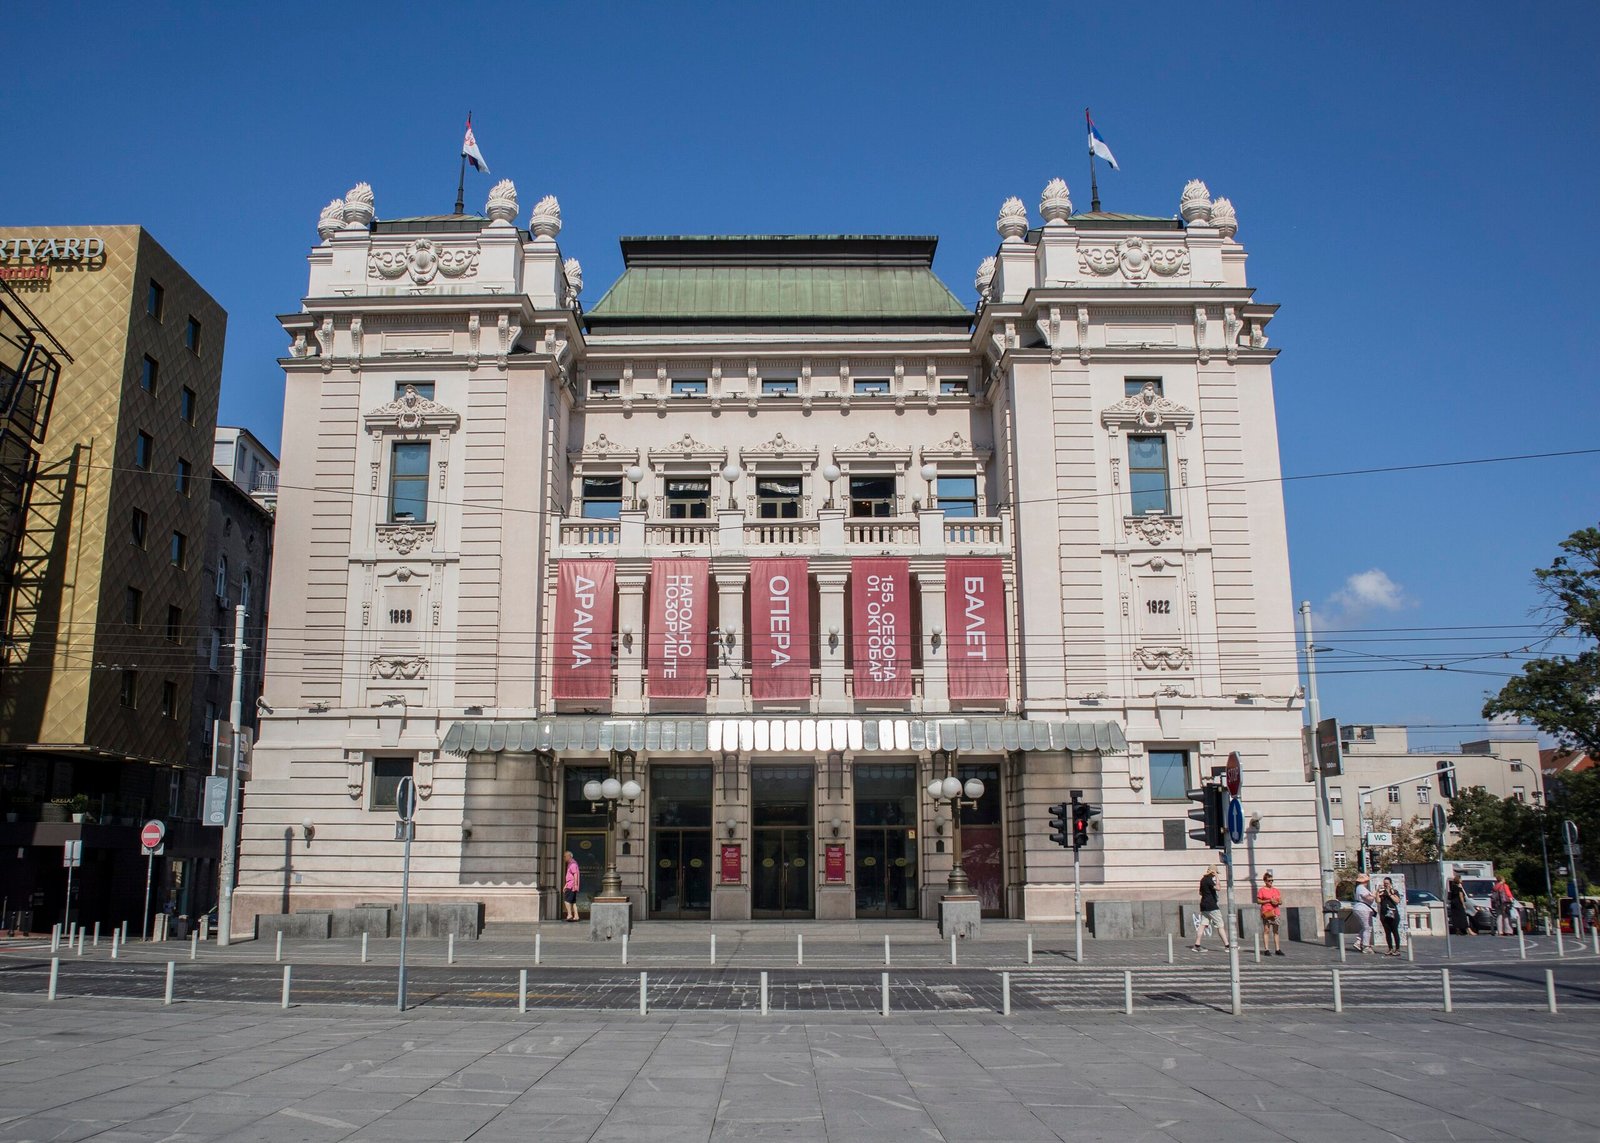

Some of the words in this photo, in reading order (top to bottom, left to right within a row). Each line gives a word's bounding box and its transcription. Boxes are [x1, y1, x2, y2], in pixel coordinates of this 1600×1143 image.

[571, 575, 595, 669] ДРАМА
[663, 575, 679, 678] ПОЗОРИШТЕ
[678, 575, 693, 657] НАРОДНО
[769, 575, 791, 668] ОПЕРА
[867, 575, 880, 597] 01.
[881, 575, 894, 607] 155.
[964, 577, 987, 661] БАЛЕТ
[867, 602, 882, 682] ОКТОБАР
[882, 612, 896, 682] СЕЗОНА
[1227, 767, 1239, 783] STOP
